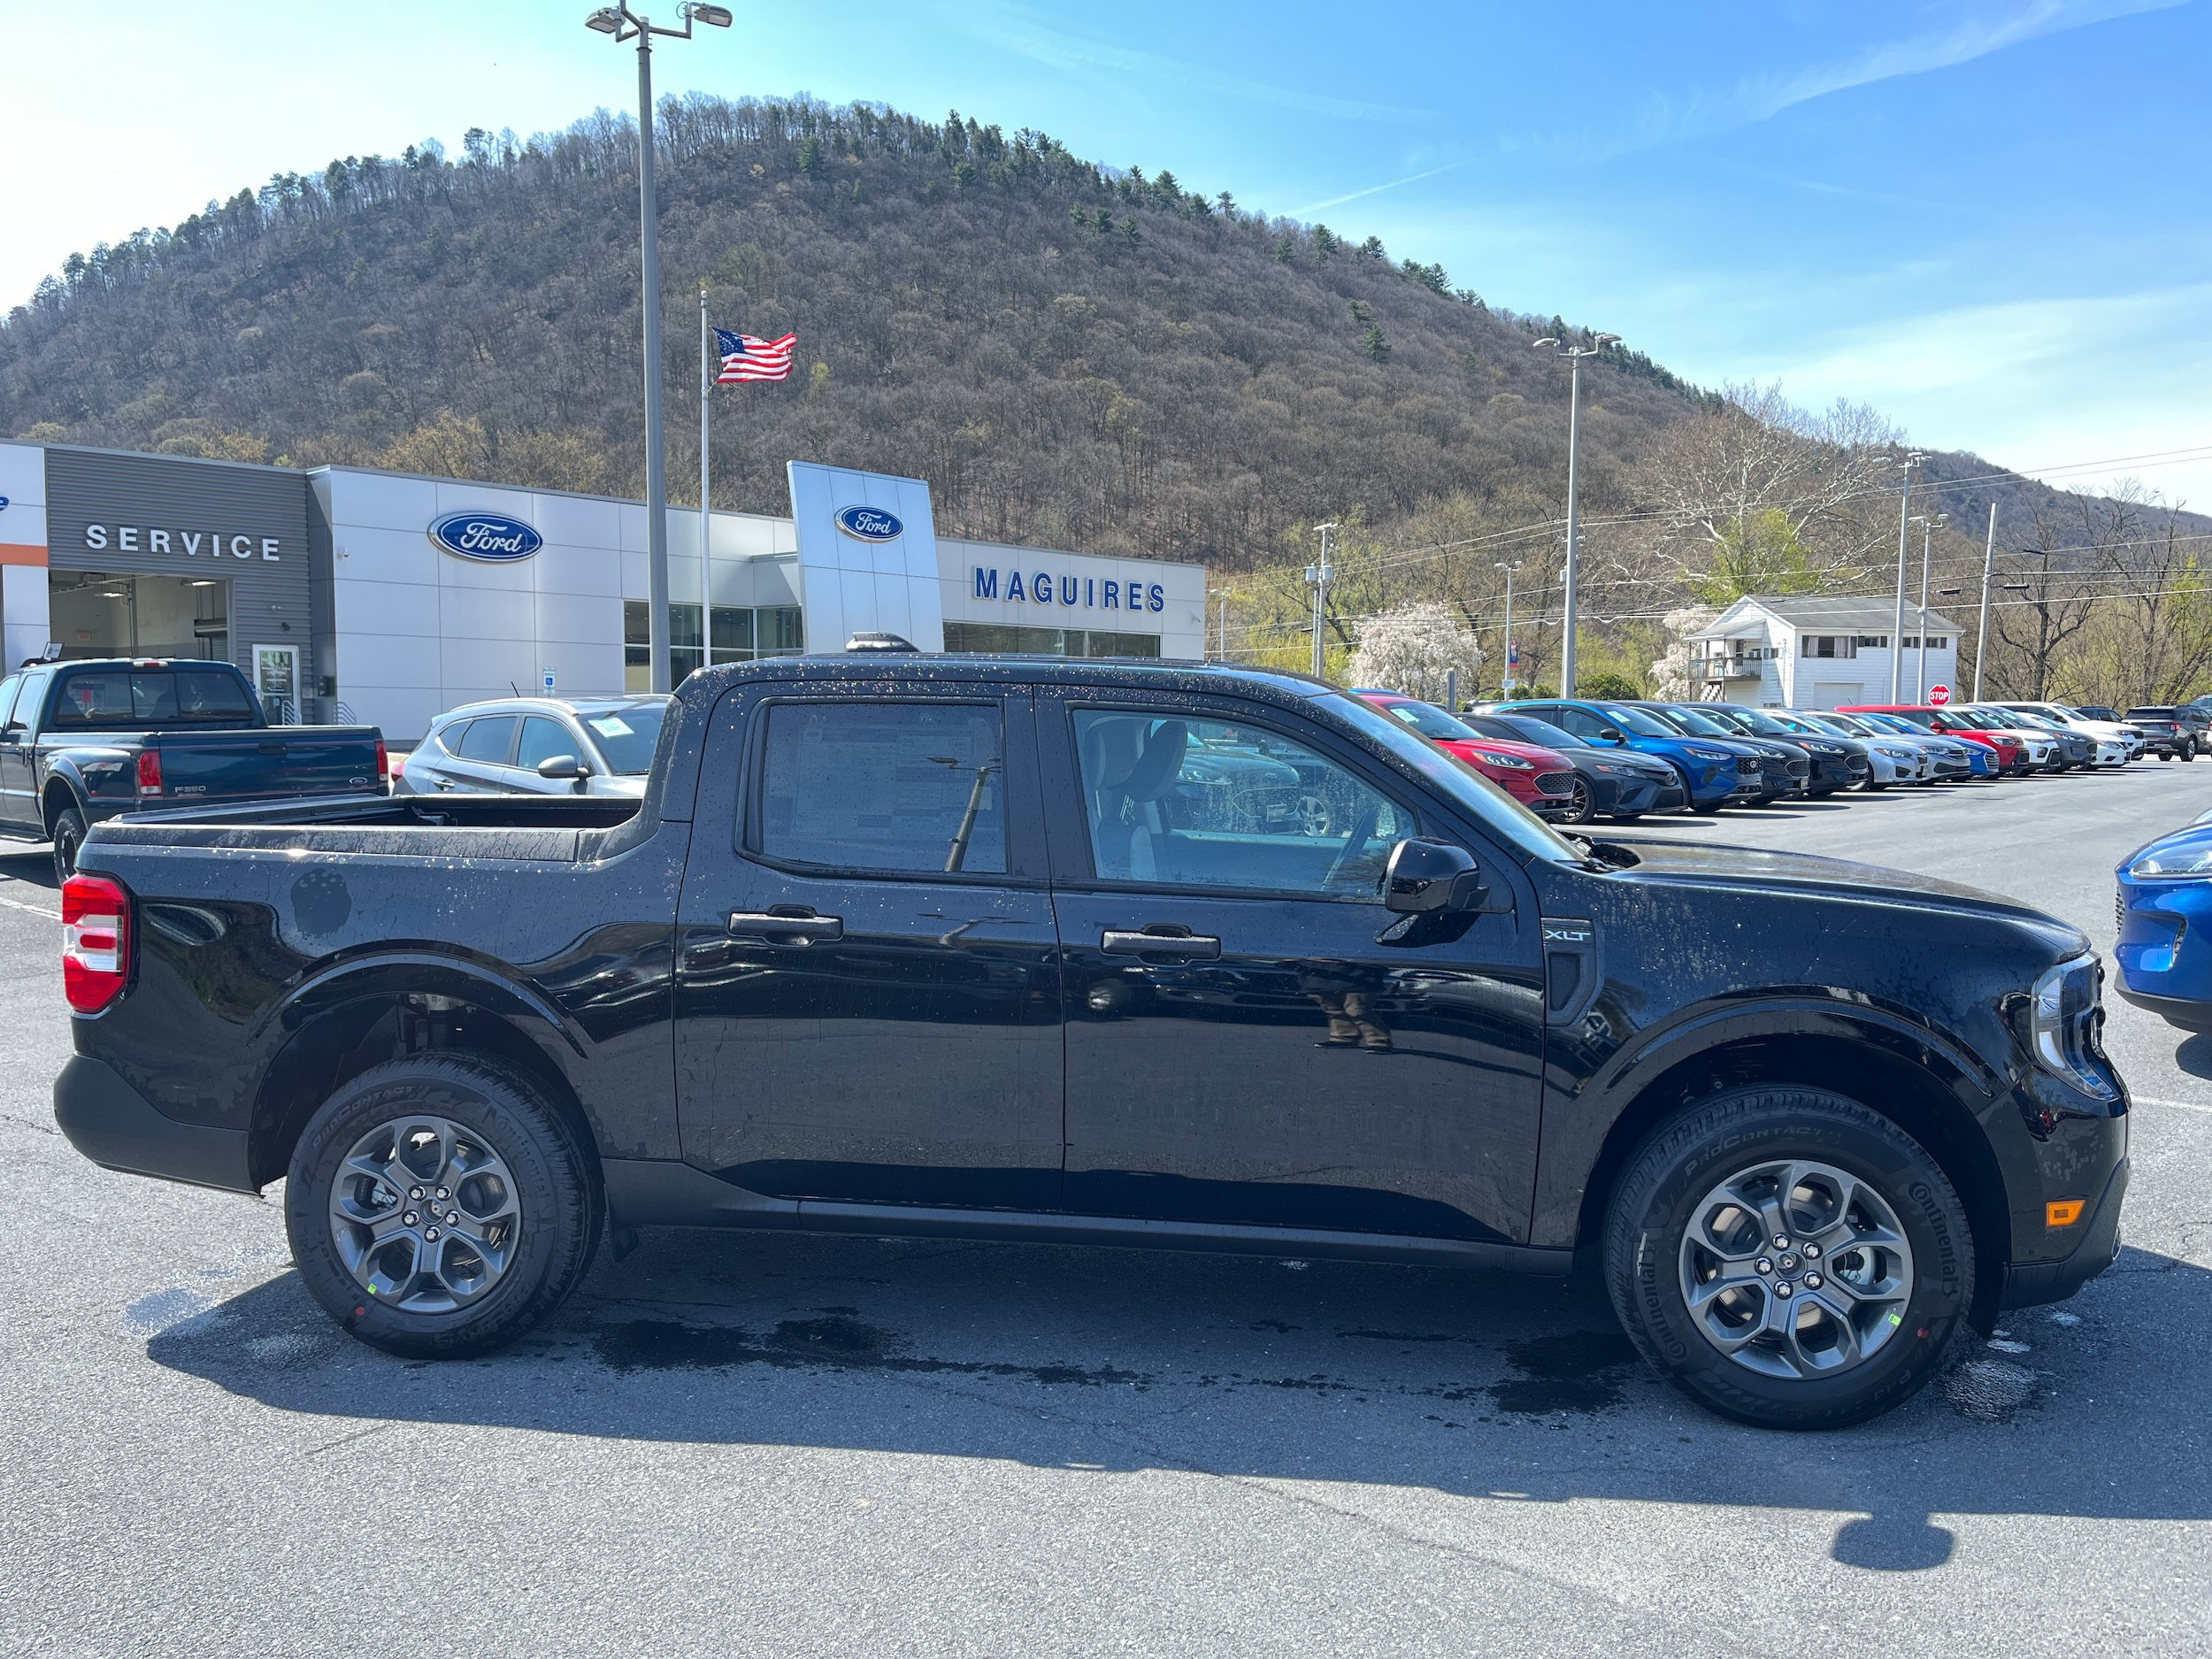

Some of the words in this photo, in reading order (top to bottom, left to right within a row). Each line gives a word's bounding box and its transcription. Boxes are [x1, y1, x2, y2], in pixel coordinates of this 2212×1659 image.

[460, 522, 523, 552] Ford
[855, 512, 892, 534] Ford
[87, 525, 280, 561] SERVICE
[976, 567, 1164, 612] MAGUIRES
[1930, 691, 1949, 701] STOP
[1545, 929, 1591, 941] XLT
[1908, 1181, 1959, 1283] Continental
[1637, 1260, 1688, 1362] Continental
